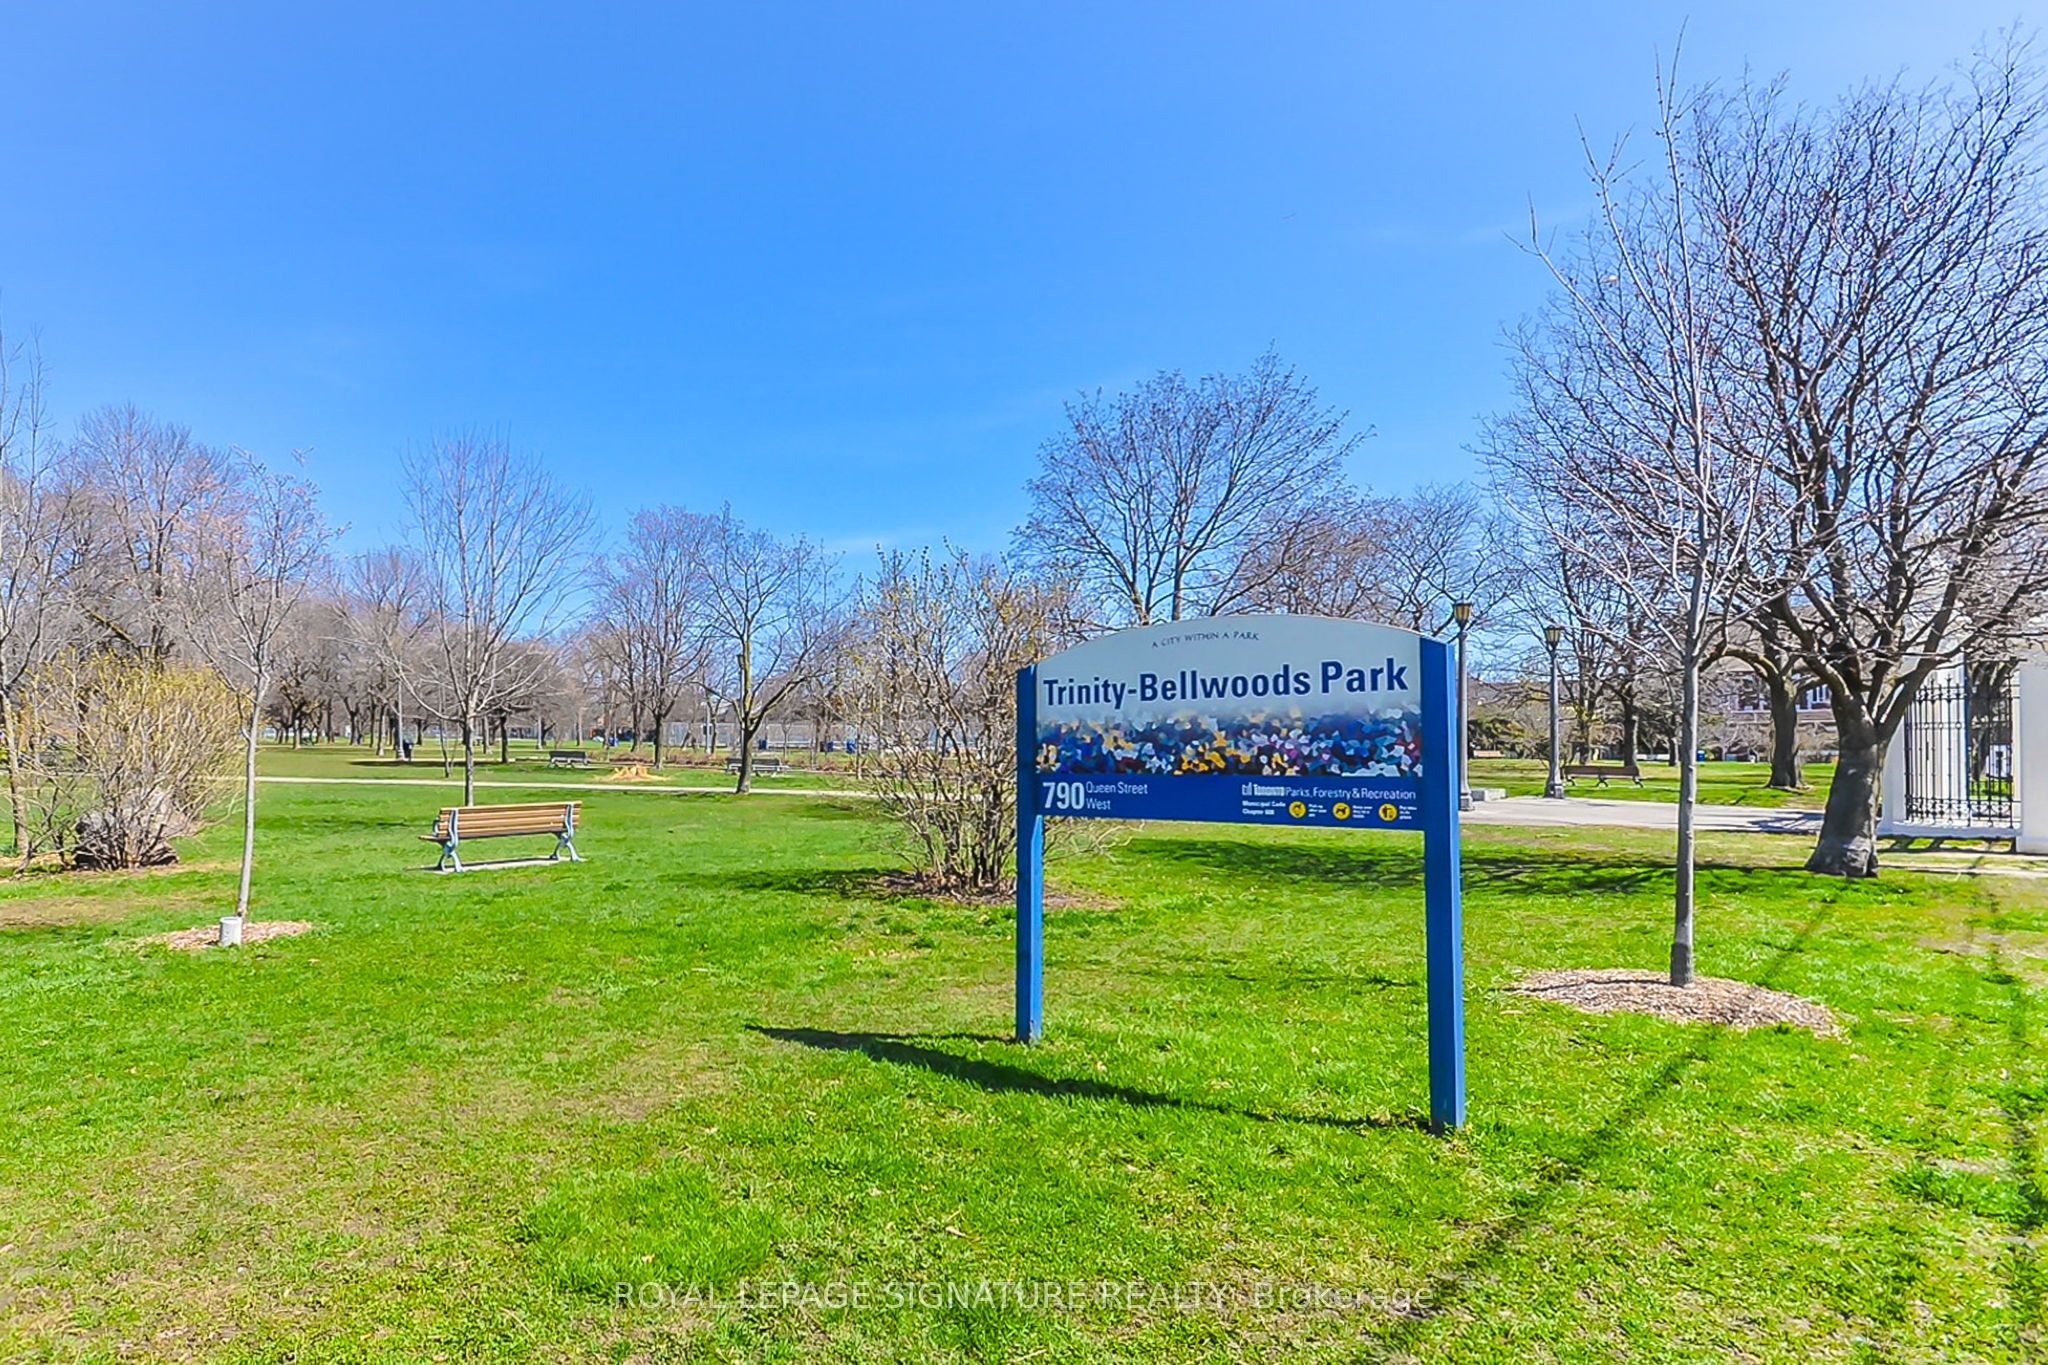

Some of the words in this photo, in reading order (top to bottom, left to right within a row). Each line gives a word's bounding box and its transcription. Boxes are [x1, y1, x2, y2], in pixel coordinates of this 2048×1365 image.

[1161, 636, 1180, 646] CITY
[1184, 631, 1219, 642] WITHIN
[1233, 631, 1260, 640] PARK
[1043, 664, 1311, 709] Trinity-Bellwoods
[1321, 657, 1409, 694] Park
[1086, 781, 1116, 793] Queen
[1117, 781, 1148, 794] Street
[1286, 787, 1313, 798] Parks,
[1313, 787, 1350, 800] Forestry
[1352, 788, 1360, 798] &
[1361, 788, 1416, 800] Recreation
[1042, 782, 1085, 809] 790
[1086, 798, 1111, 810] West
